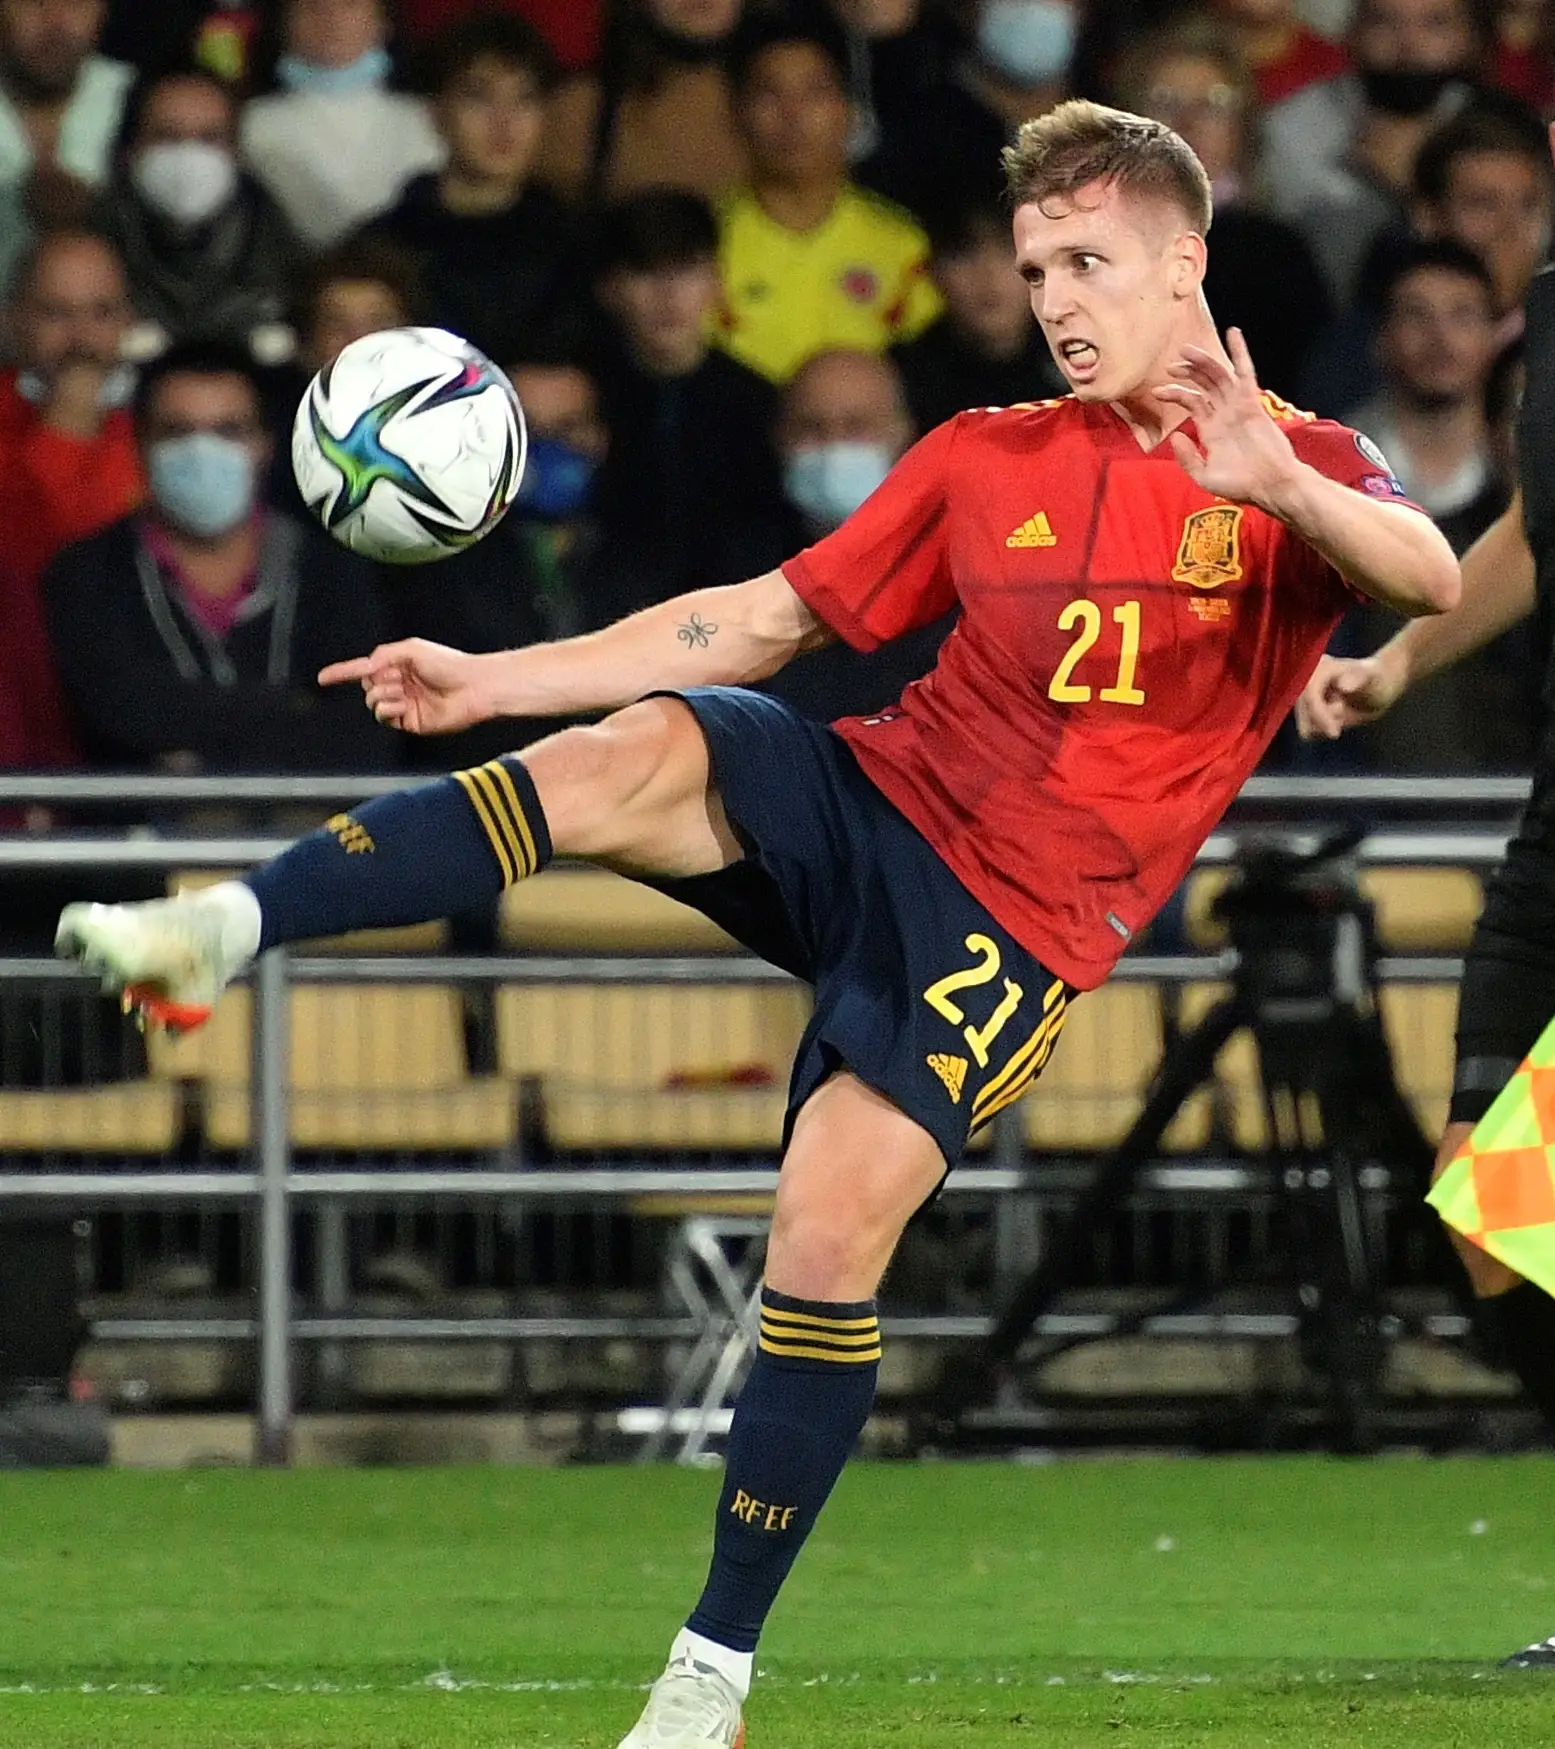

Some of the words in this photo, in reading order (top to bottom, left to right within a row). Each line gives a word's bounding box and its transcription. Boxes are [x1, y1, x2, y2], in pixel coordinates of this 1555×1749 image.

[1005, 533, 1057, 548] adidas
[1048, 599, 1145, 706] 21
[923, 933, 1024, 1069] 21
[926, 1053, 961, 1104] adidas
[730, 1488, 799, 1530] RFEF
